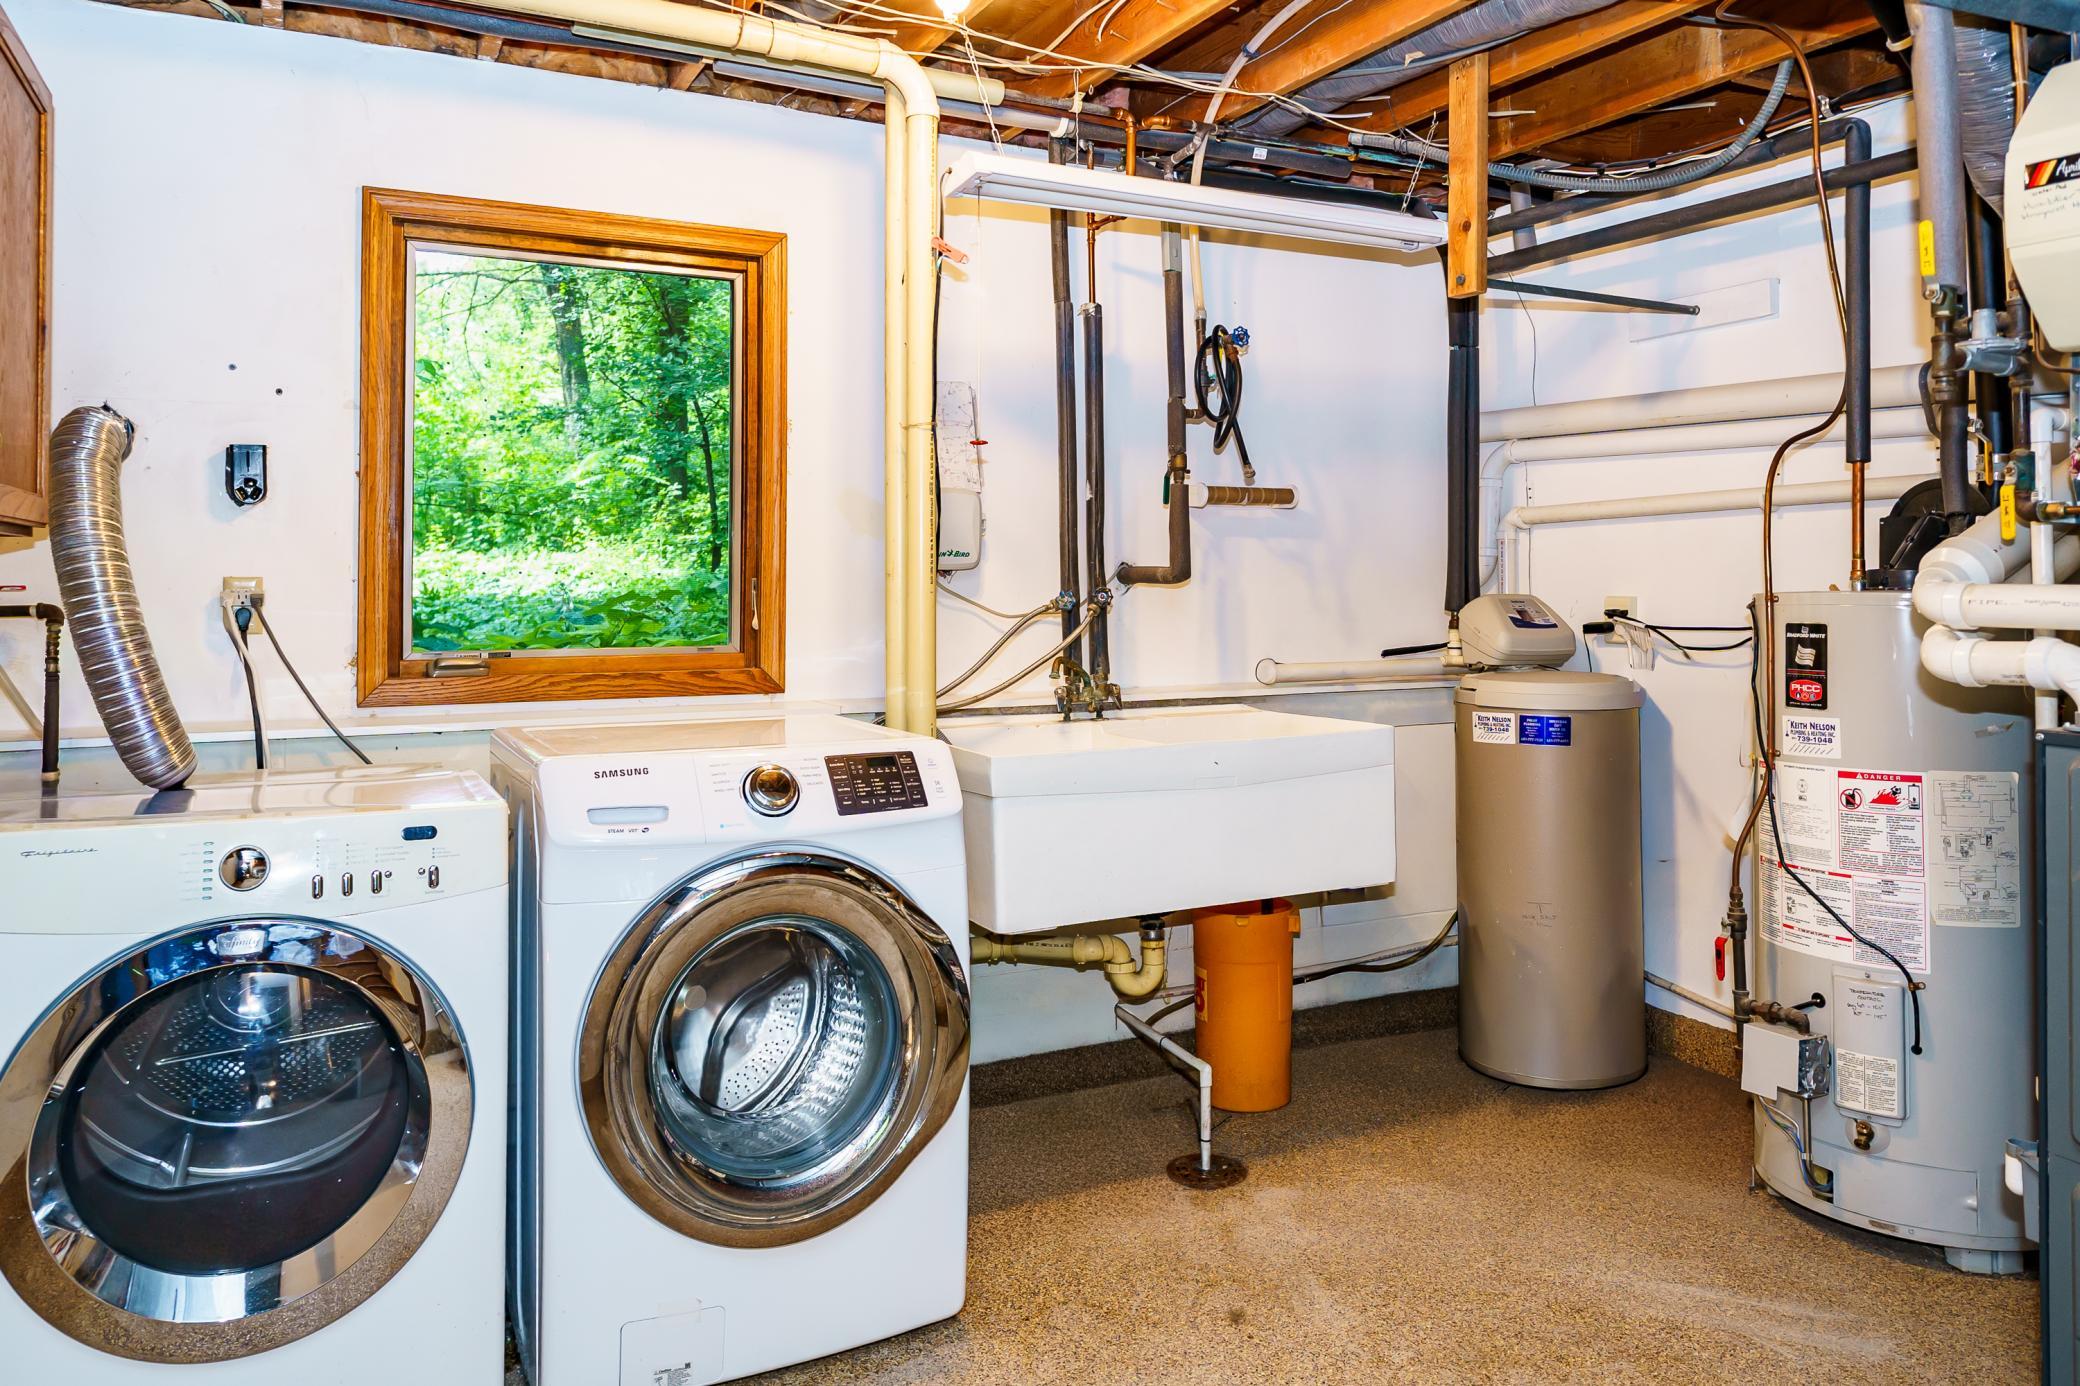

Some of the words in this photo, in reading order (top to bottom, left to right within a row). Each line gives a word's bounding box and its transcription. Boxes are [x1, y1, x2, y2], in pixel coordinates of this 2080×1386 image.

[1791, 683, 1821, 693] PHCC
[1790, 721, 1808, 730] KEITH
[1810, 722, 1836, 731] NELSON
[594, 767, 649, 779] SAMSUNG
[1864, 773, 1901, 781] DANGER
